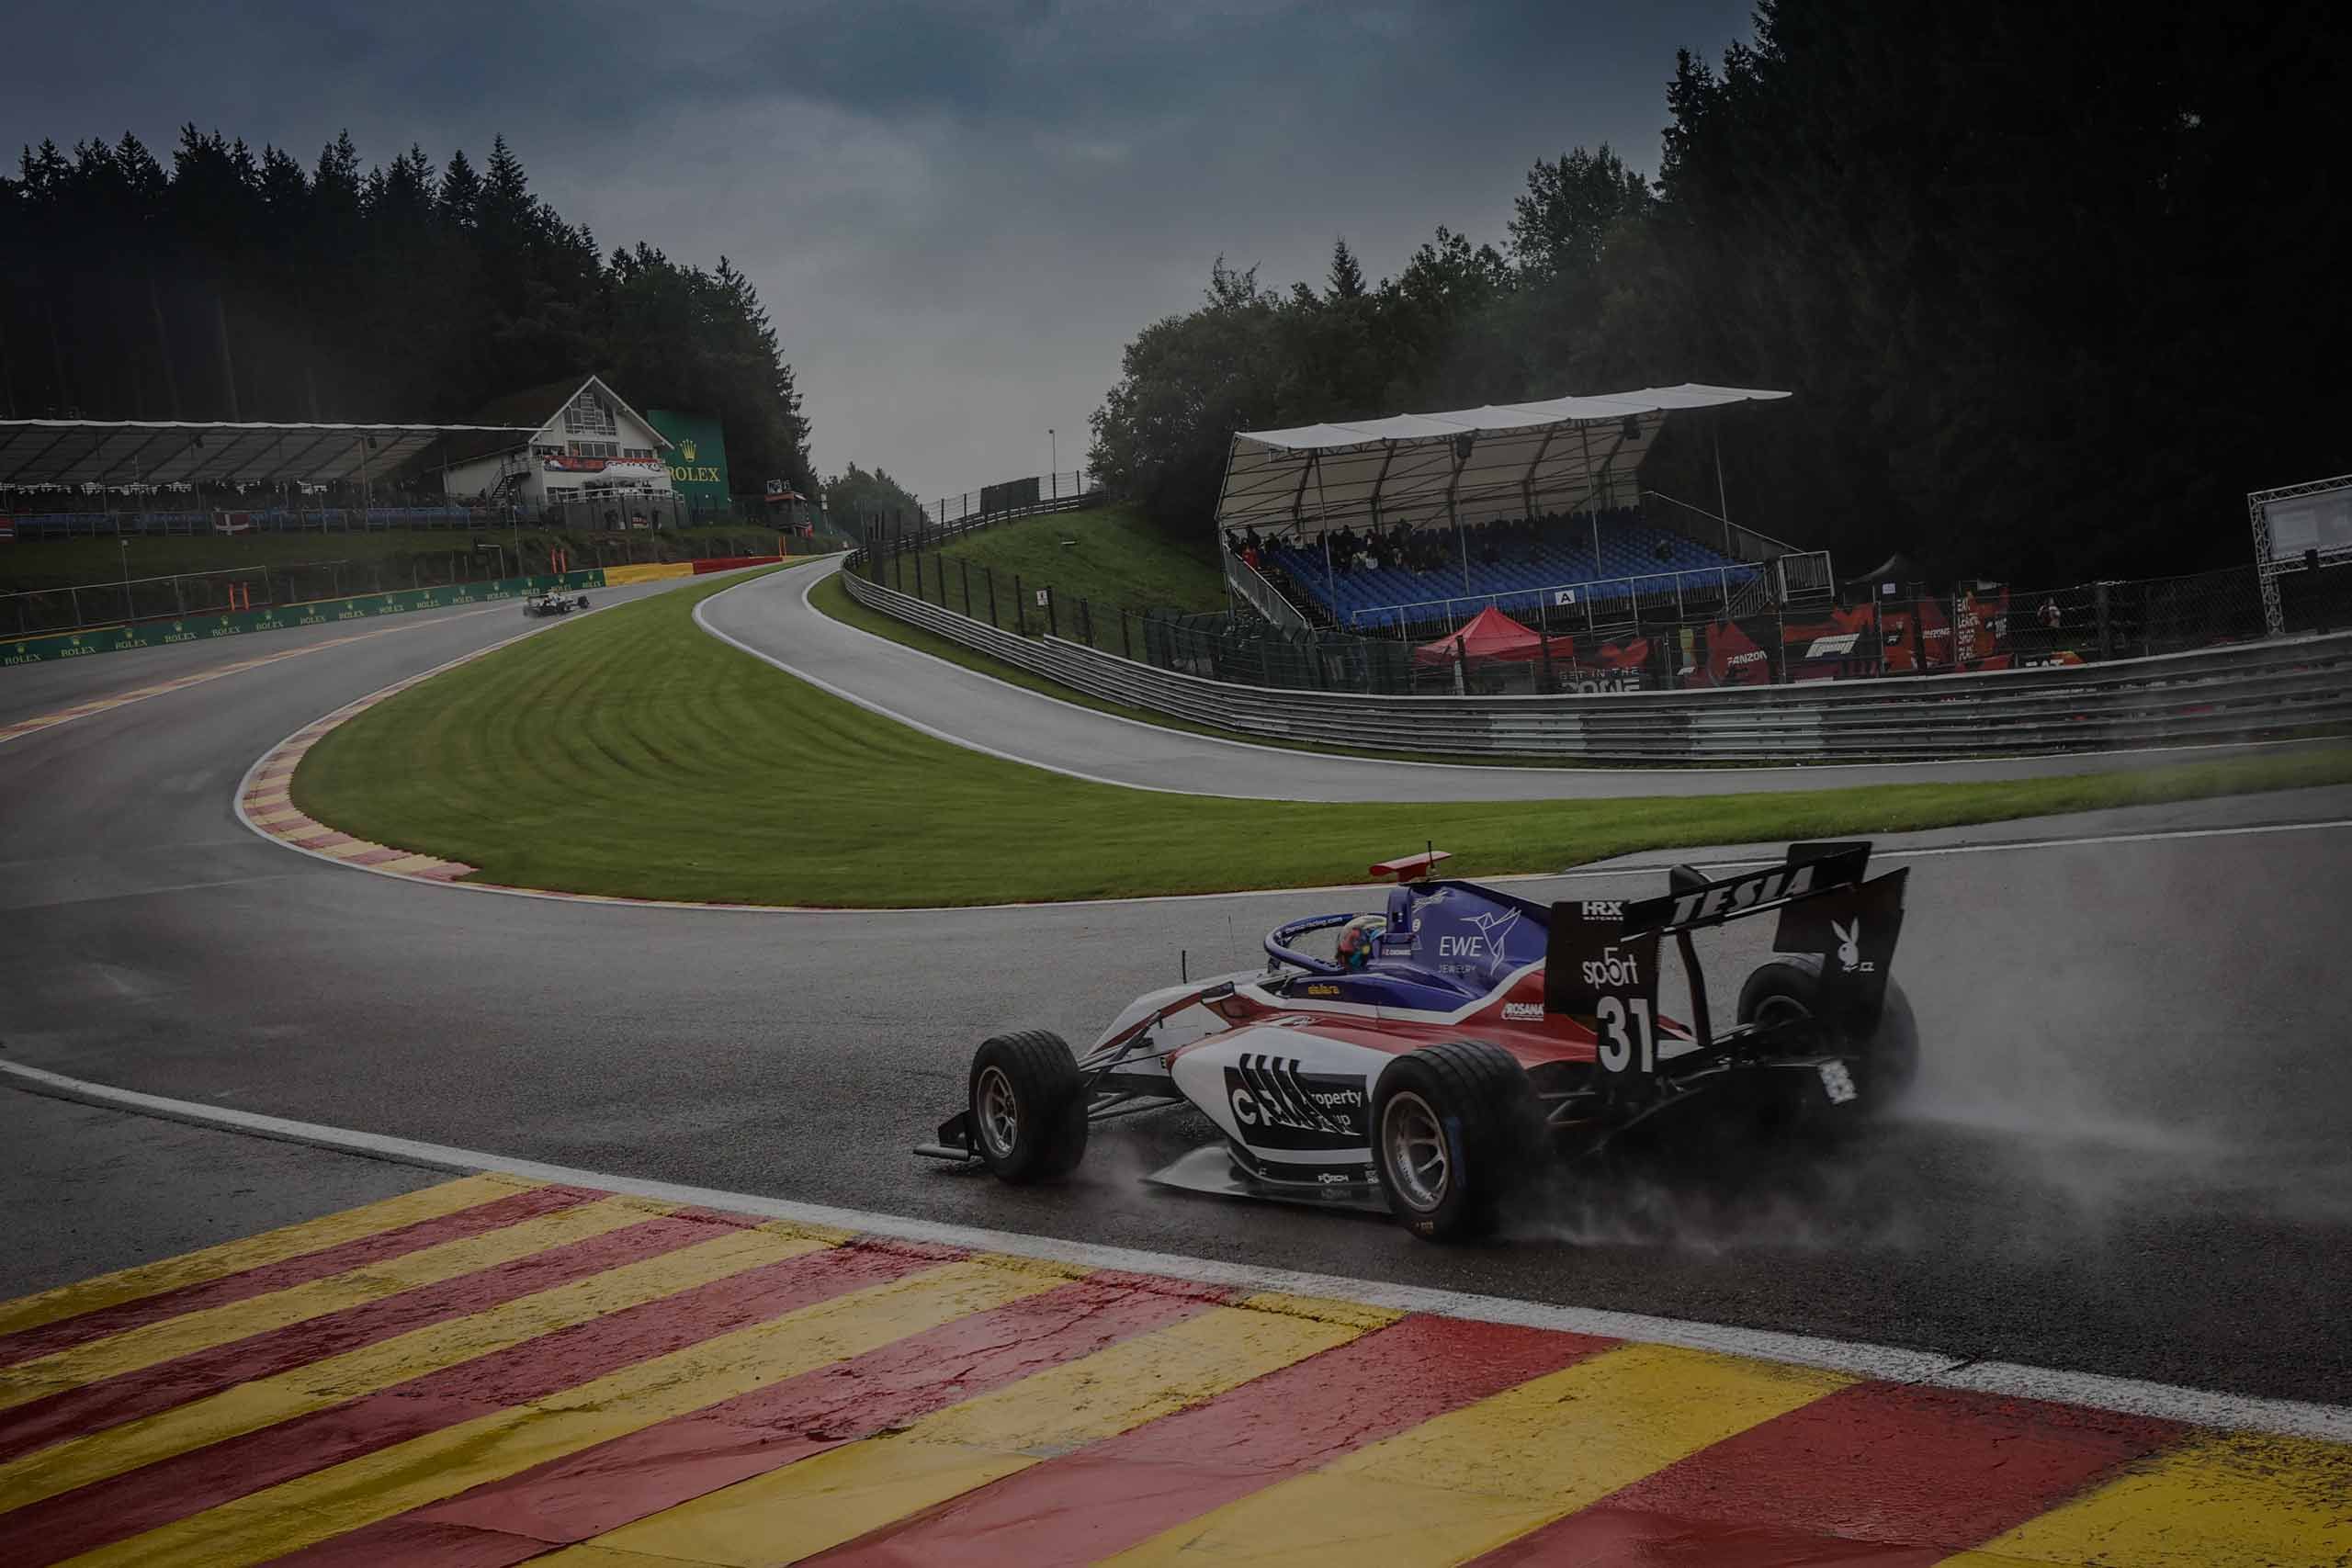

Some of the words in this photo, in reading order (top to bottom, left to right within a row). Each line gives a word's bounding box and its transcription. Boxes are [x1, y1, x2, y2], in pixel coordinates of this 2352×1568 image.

[668, 467, 721, 482] ROLEX
[1561, 592, 1571, 604] A
[115, 639, 148, 649] ROLEX
[164, 632, 198, 643] ROLEX
[60, 646, 96, 657] ROLEX
[5, 653, 43, 666] ROLEX
[1581, 901, 1624, 916] HRX
[1439, 935, 1483, 957] EWE
[1597, 996, 1654, 1073] 31
